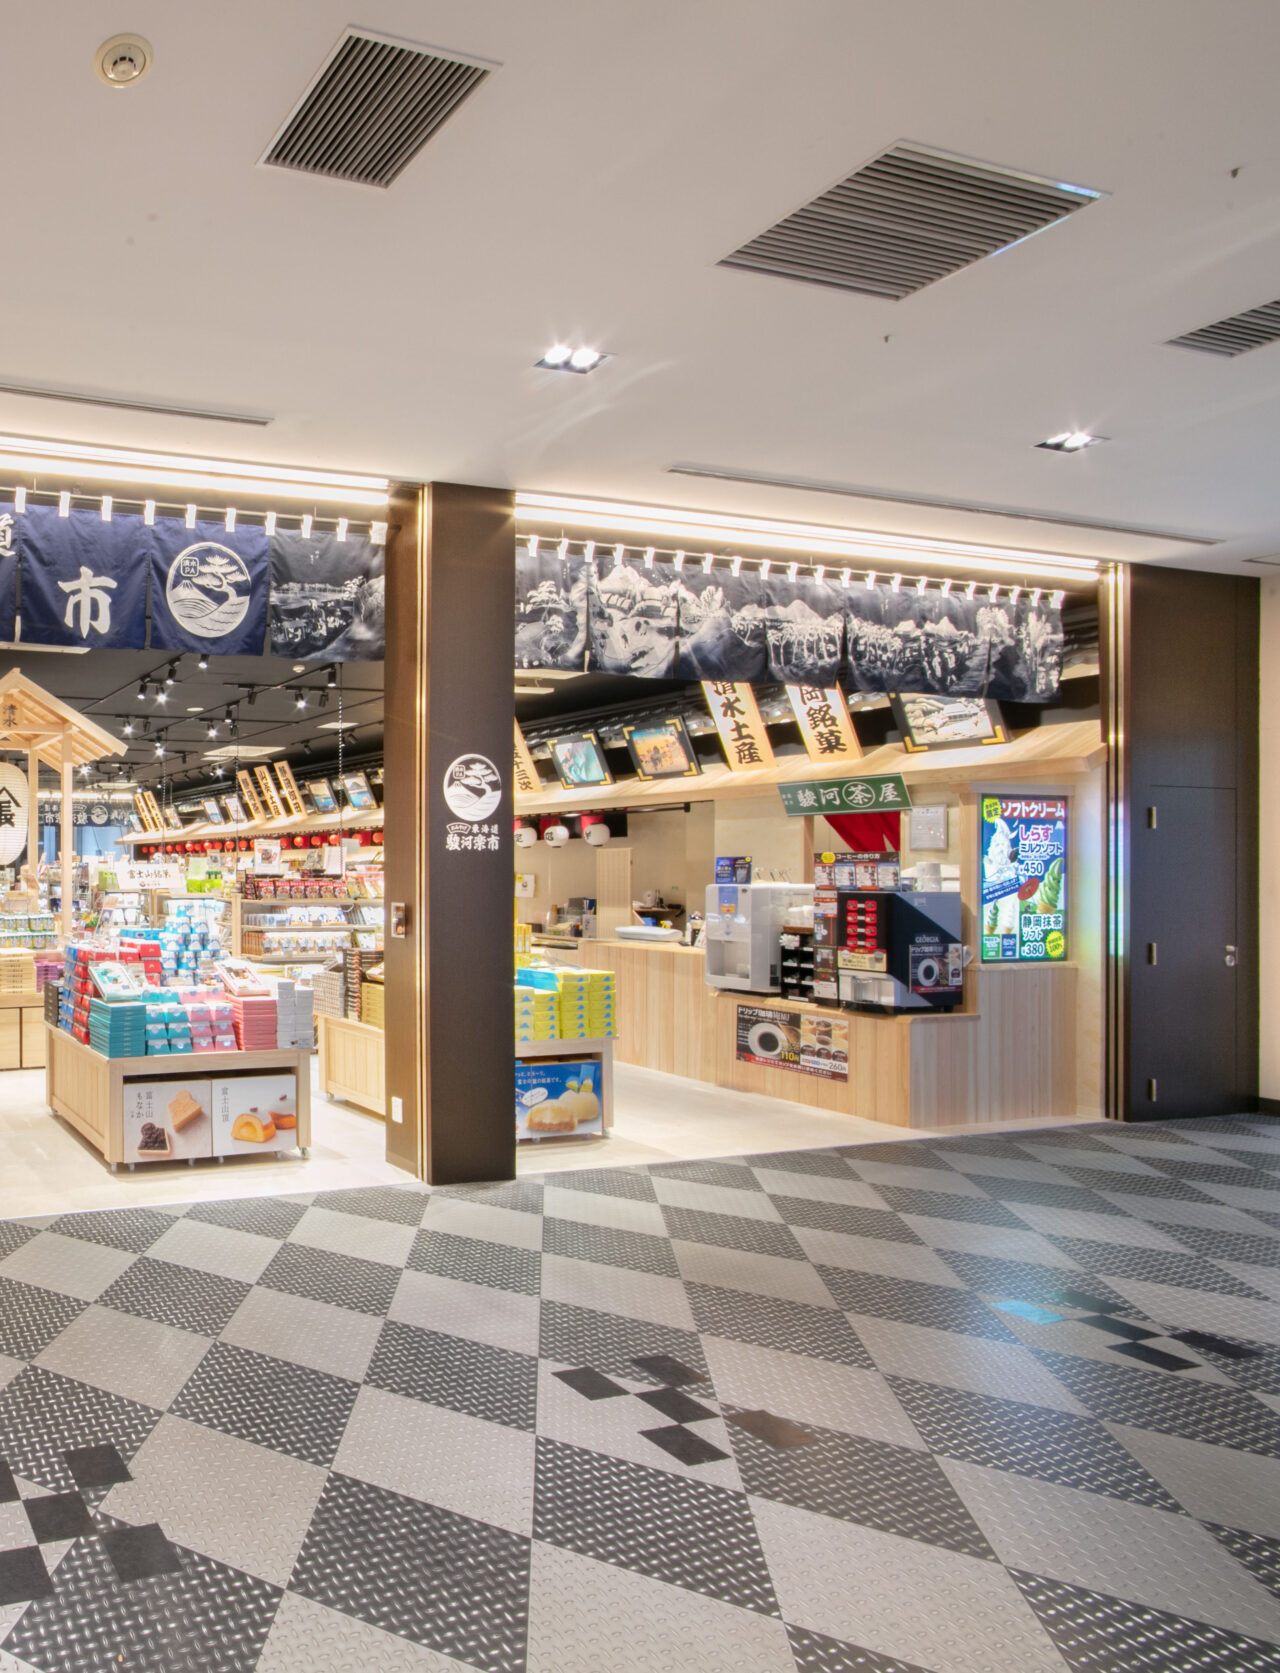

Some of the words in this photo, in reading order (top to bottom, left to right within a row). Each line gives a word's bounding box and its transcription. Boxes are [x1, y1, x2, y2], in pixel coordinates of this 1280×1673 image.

[1002, 801, 1065, 818] ソフトクリーム
[471, 823, 499, 834] 東海道
[1020, 824, 1053, 842] しらす
[445, 834, 500, 851] 駿河楽市
[1020, 843, 1063, 855] ミルクソフト
[1022, 914, 1063, 929] 静岡抹茶
[1023, 929, 1043, 941] ソフト
